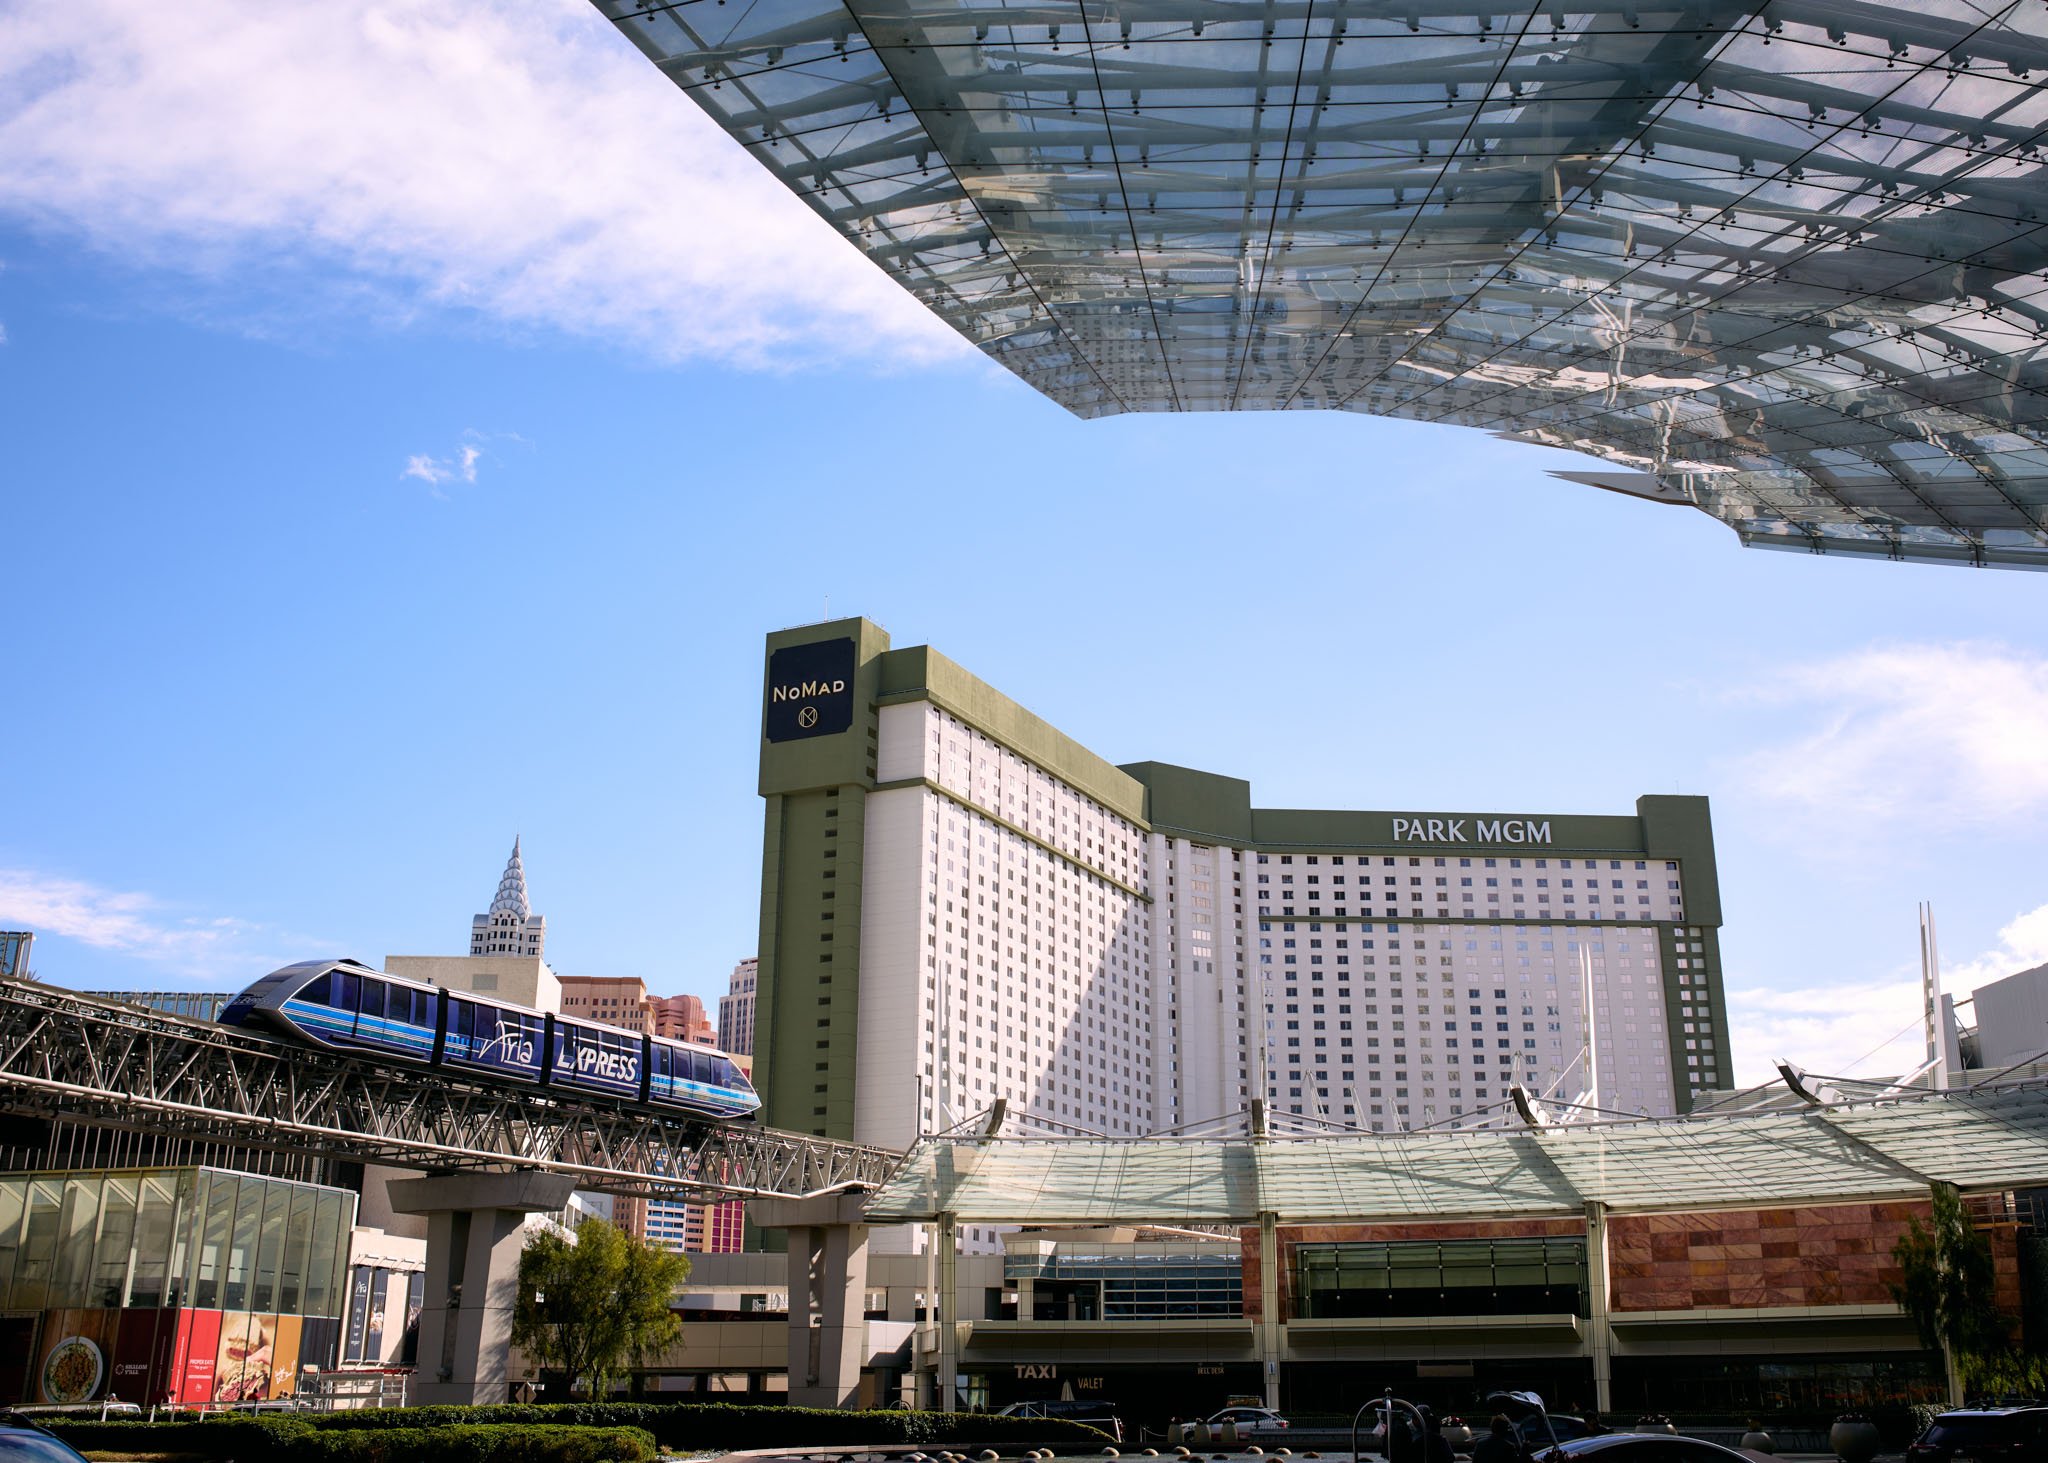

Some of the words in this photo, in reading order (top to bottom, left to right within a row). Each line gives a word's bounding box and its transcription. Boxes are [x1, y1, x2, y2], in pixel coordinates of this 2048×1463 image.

[1392, 818, 1468, 842] PARK
[1476, 820, 1552, 844] MGM
[478, 1020, 534, 1064] Aria
[1014, 1364, 1057, 1379] TAXI
[1077, 1377, 1104, 1390] VALET
